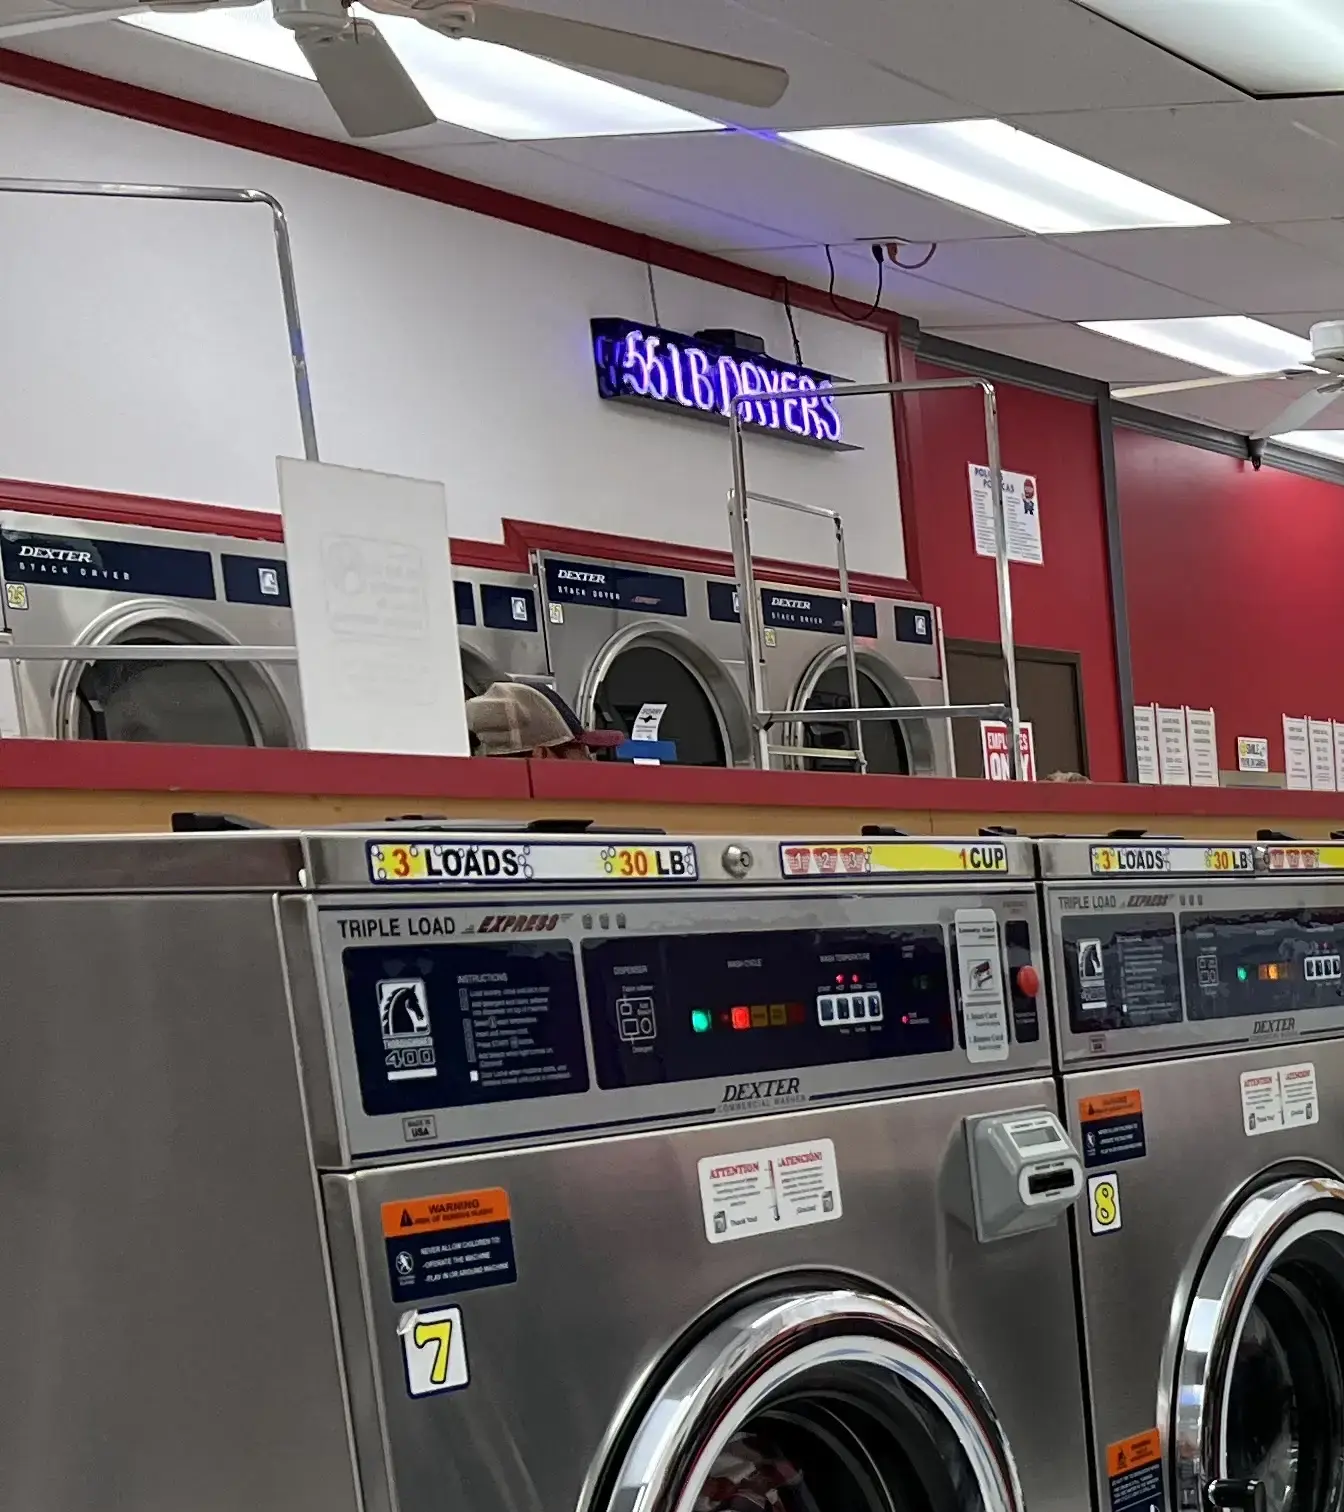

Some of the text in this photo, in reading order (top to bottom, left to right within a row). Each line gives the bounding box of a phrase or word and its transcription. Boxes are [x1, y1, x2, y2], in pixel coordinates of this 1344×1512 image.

[717, 355, 843, 441] DRYERS
[18, 545, 93, 564] DEXTER
[19, 561, 131, 581] STACK DRYER
[557, 569, 606, 584] DEXTER
[771, 597, 811, 610] DEXTER
[987, 732, 1029, 750] EMPLES
[989, 752, 1030, 781] ONY
[392, 848, 686, 877] 3 LOADS 30 LB
[970, 847, 1004, 870] CUP
[1102, 850, 1248, 870] 3 LOADS 30 LB
[1058, 896, 1089, 910] TRIPLE
[1092, 895, 1117, 909] LOAD
[337, 913, 561, 939] TRIPLE LOAD EXPRESS
[1252, 1017, 1296, 1034] DEXTER
[385, 1047, 437, 1069] 400
[722, 1077, 801, 1103] DEXTER
[411, 1127, 430, 1138] USA
[709, 1161, 760, 1180] ATTENTION
[428, 1199, 480, 1214] WARNING
[1094, 1181, 1117, 1226] 8
[414, 1318, 453, 1385] 7
